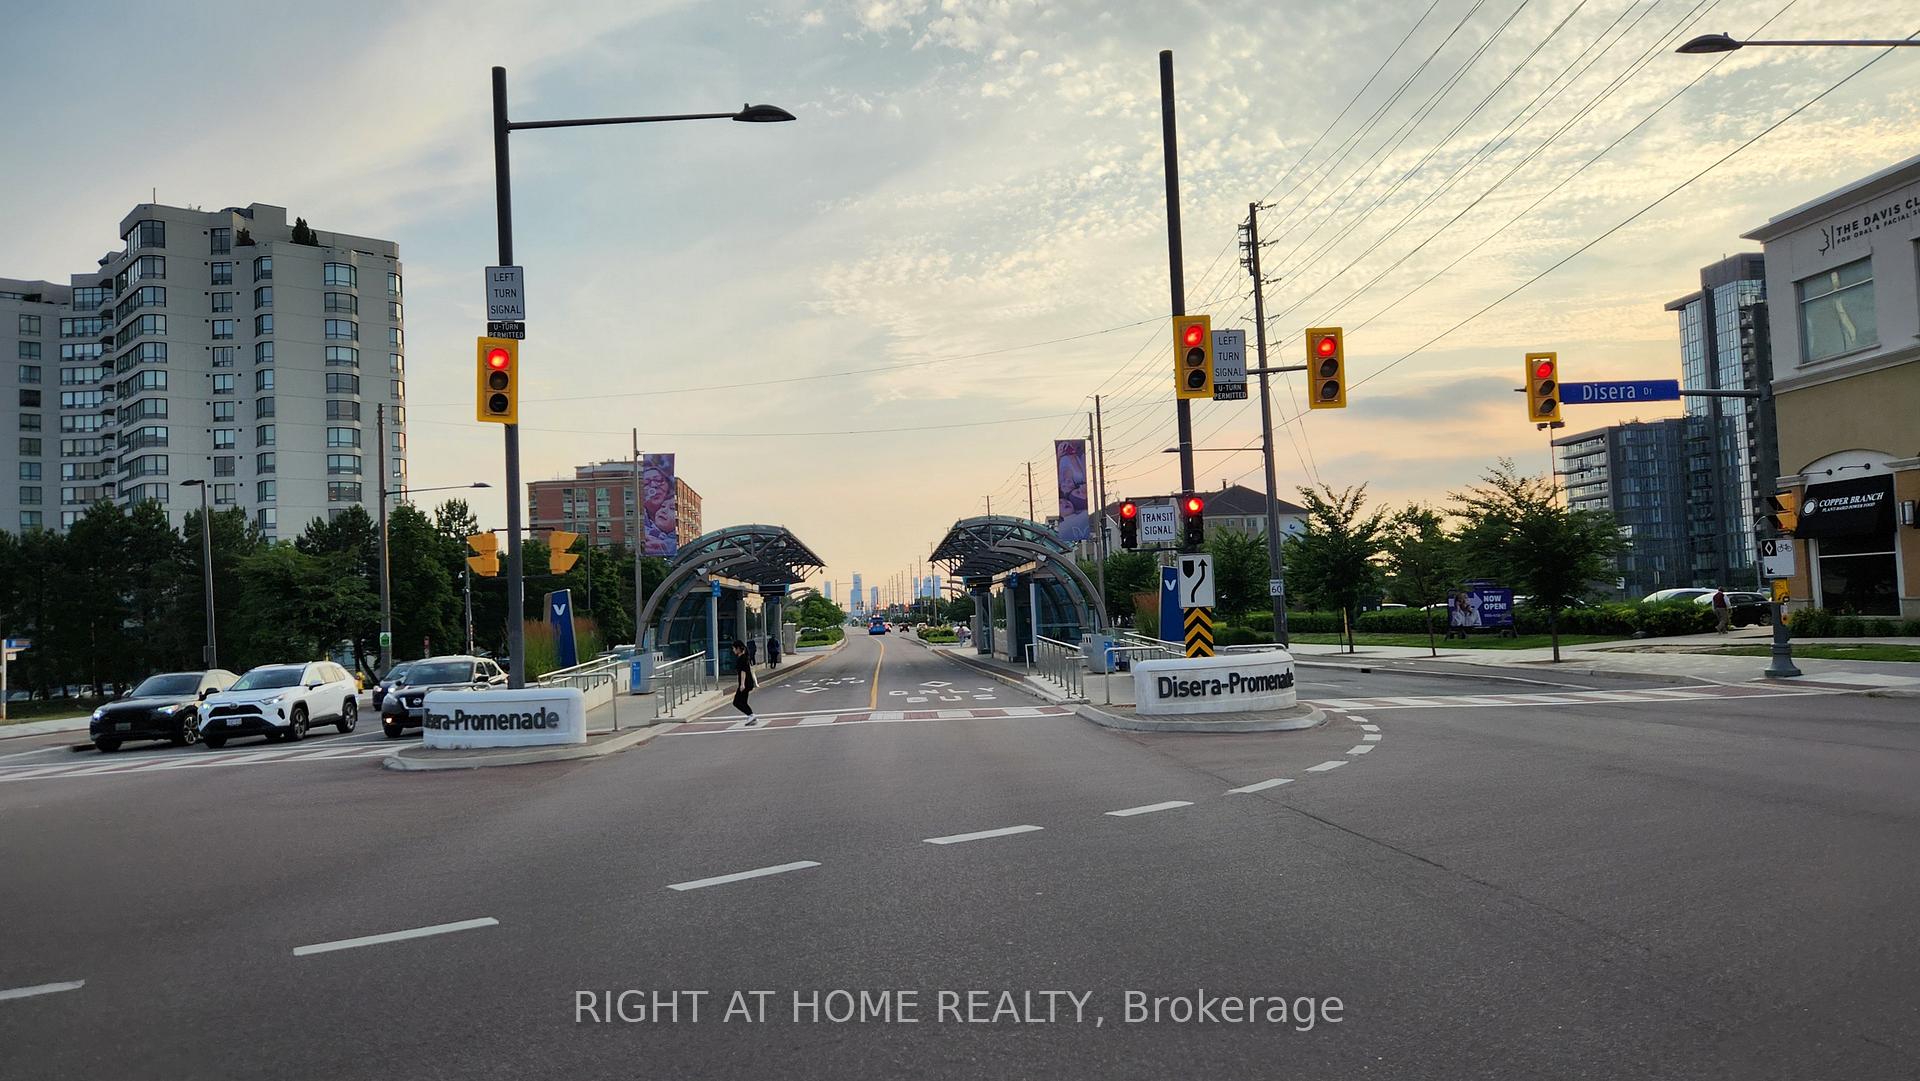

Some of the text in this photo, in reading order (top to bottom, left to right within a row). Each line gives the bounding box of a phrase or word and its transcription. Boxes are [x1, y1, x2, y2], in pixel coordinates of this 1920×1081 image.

[1836, 221, 1859, 236] THE
[1864, 204, 1901, 226] DAVIS
[1837, 235, 1851, 245] FOR
[1853, 227, 1873, 239] ORAL
[1883, 212, 1911, 228] FACIAL
[494, 273, 514, 282] LEFT
[494, 289, 517, 298] TURN
[490, 305, 522, 315] SIGNAL
[493, 323, 519, 331] U-TURN
[1218, 336, 1237, 345] LEFT
[1218, 352, 1240, 361] TURN
[1215, 367, 1243, 377] SIGNAL
[1214, 391, 1247, 400] PERMITTED
[1582, 383, 1653, 401] Disera Dr
[1818, 491, 1885, 507] COPPER BRANCH
[1142, 512, 1174, 523] TRANSIT
[1144, 526, 1173, 535] SIGNAL
[1271, 585, 1282, 594] 60
[1157, 667, 1295, 699] Disera-Promenade
